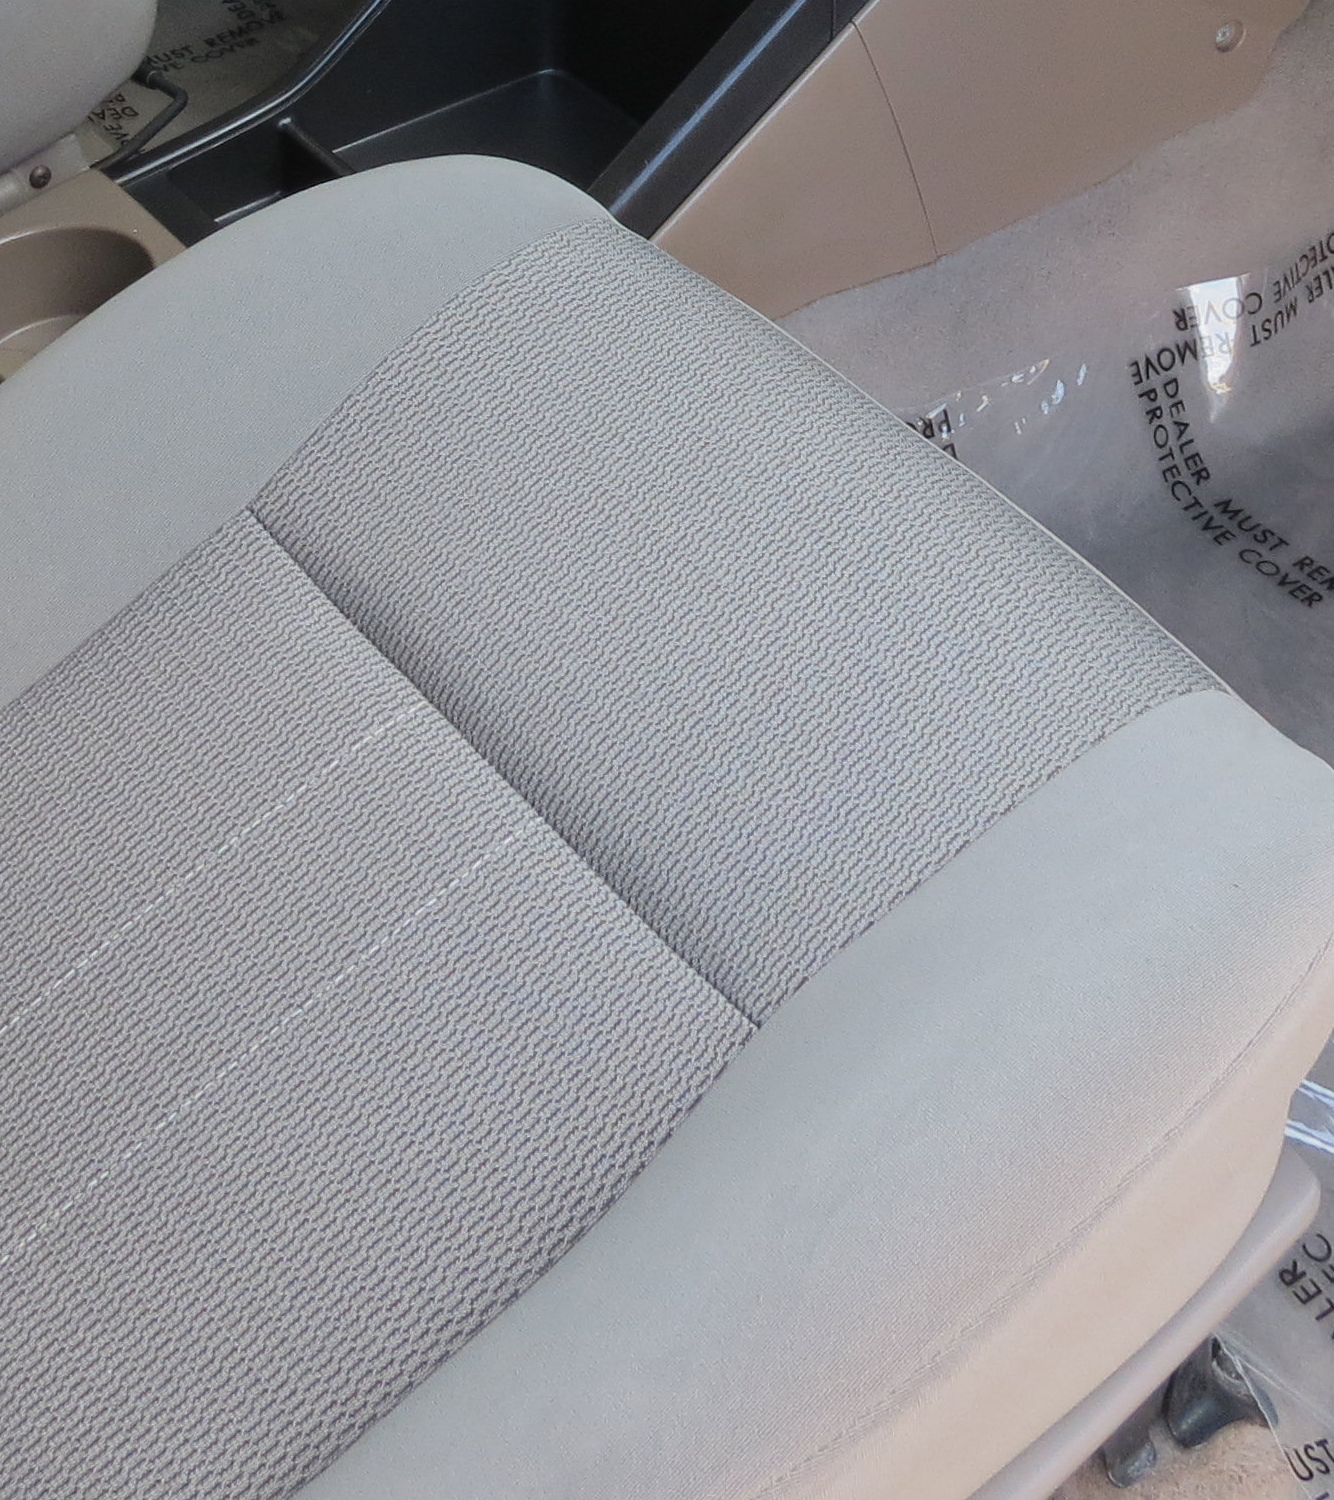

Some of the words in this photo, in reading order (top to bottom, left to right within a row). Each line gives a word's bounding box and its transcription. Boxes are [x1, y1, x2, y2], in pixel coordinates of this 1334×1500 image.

[1172, 292, 1264, 332] COVER
[1250, 303, 1298, 346] MUST
[1130, 332, 1232, 386] REMOVE
[1163, 377, 1211, 486] DEALER
[1214, 499, 1289, 551] MUST
[1138, 387, 1237, 546] PROTECTIVE
[1238, 549, 1323, 609] COVER
